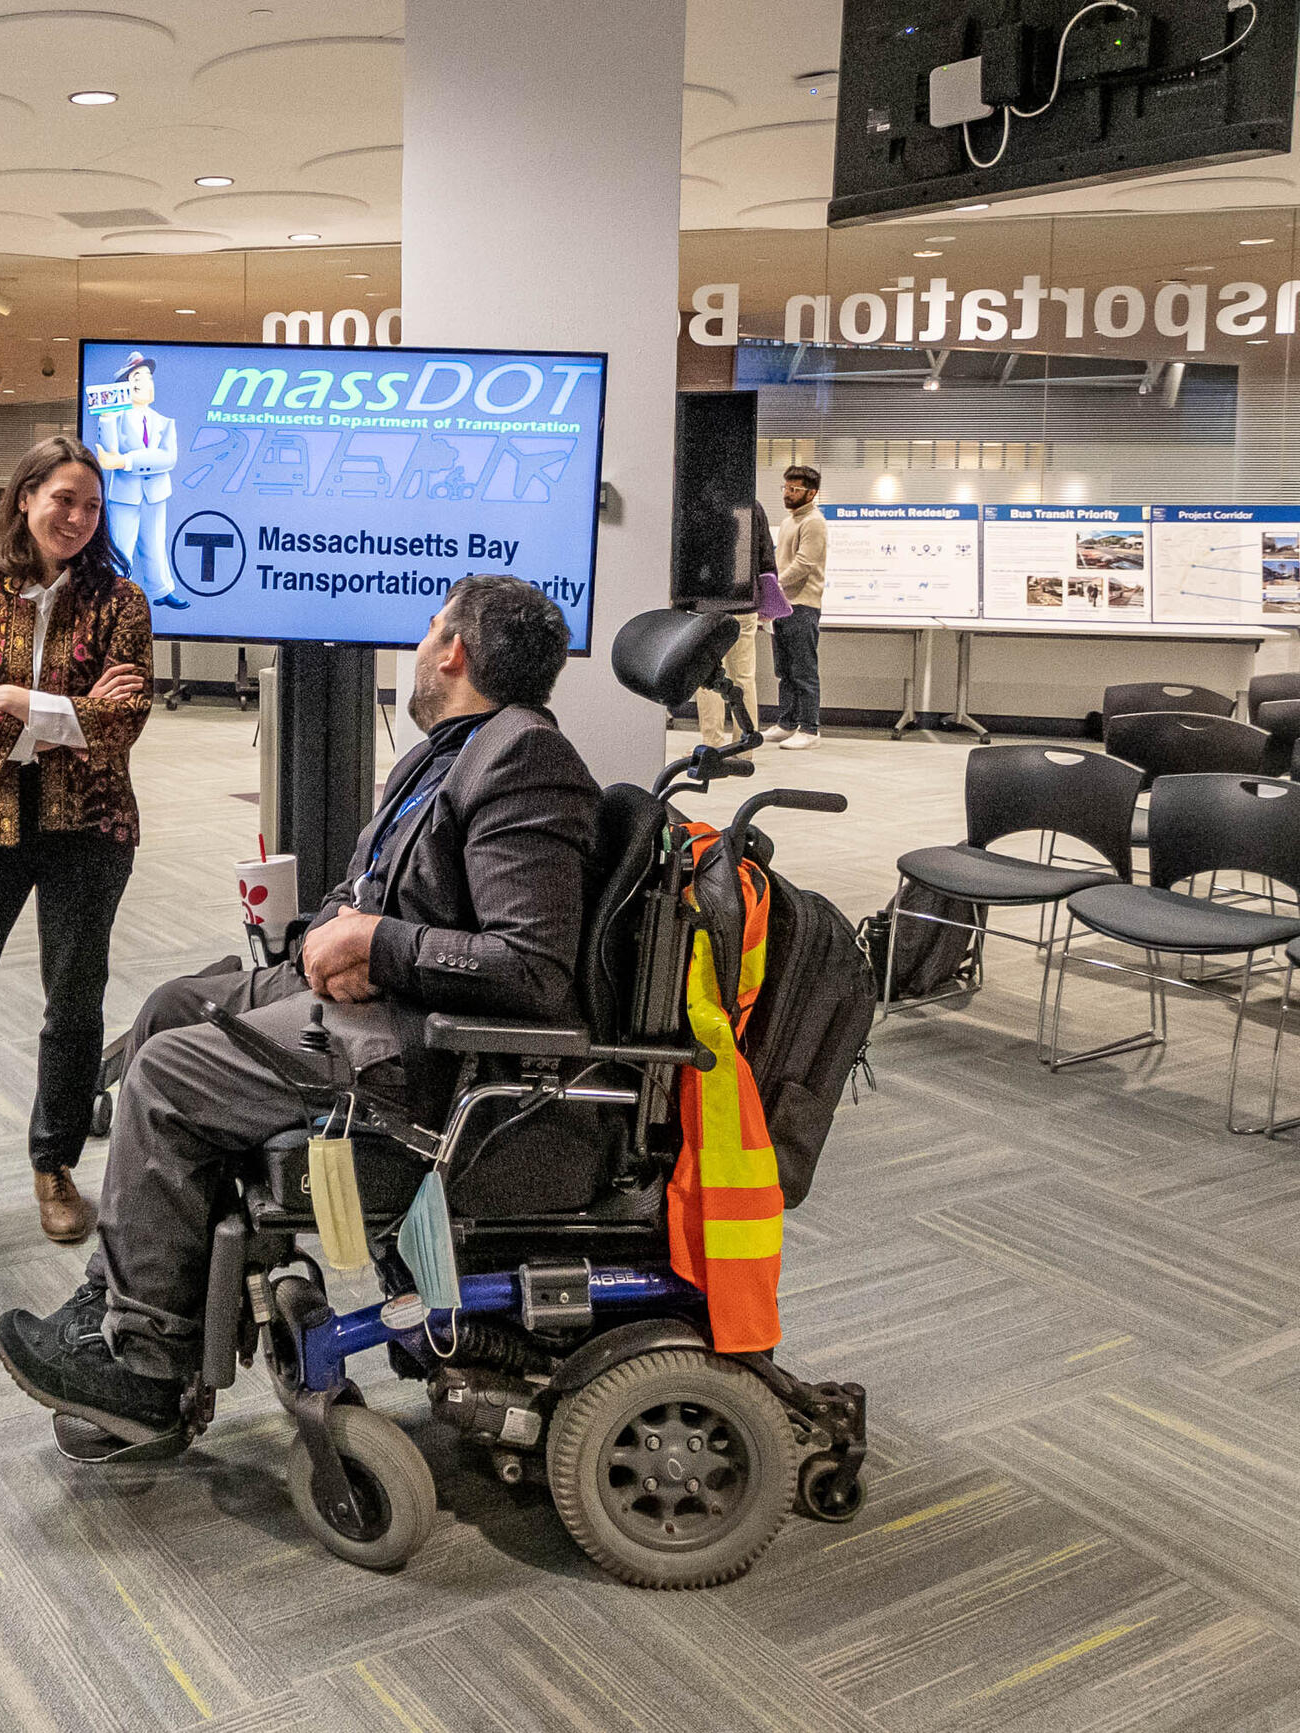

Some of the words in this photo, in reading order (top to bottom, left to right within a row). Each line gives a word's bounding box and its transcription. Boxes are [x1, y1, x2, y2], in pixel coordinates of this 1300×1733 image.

[211, 360, 602, 416] massDOT
[206, 410, 323, 425] Massachusetts
[328, 414, 429, 430] Department
[433, 418, 452, 430] of
[456, 418, 580, 433] Transportation
[836, 508, 858, 518] Bus
[860, 507, 905, 518] Network
[908, 508, 960, 519] Redesign
[1010, 509, 1033, 519] Bus
[1034, 509, 1075, 519] Transit
[1077, 510, 1120, 521] Priority
[1178, 511, 1212, 520] Project
[1213, 511, 1254, 520] Corridor
[184, 533, 235, 582] T
[258, 526, 458, 558] Massachusetts
[468, 533, 520, 566] Bay
[256, 564, 452, 598] Transportation
